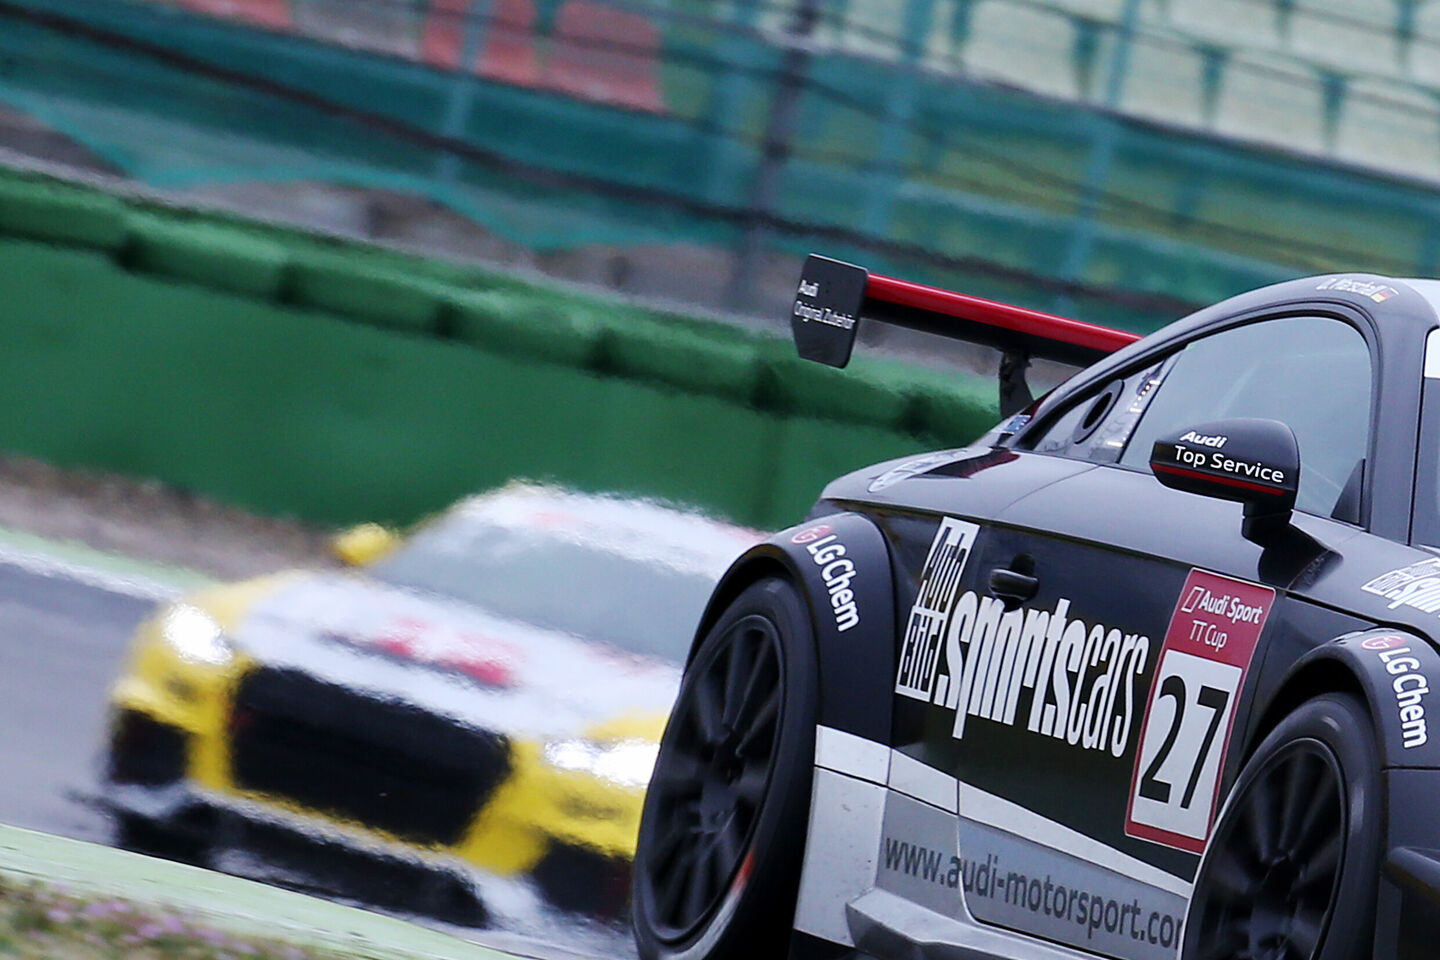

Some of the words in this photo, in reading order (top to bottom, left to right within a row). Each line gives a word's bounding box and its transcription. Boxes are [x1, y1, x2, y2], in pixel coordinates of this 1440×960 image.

[1180, 431, 1227, 448] Audi
[1175, 445, 1206, 468] Top
[1210, 453, 1284, 483] Service
[1198, 590, 1230, 615] Audi
[1226, 597, 1263, 624] Sport
[1190, 620, 1208, 641] TT
[1205, 624, 1227, 652] Cup
[933, 590, 1150, 758] sportscars
[1138, 675, 1230, 810] 27
